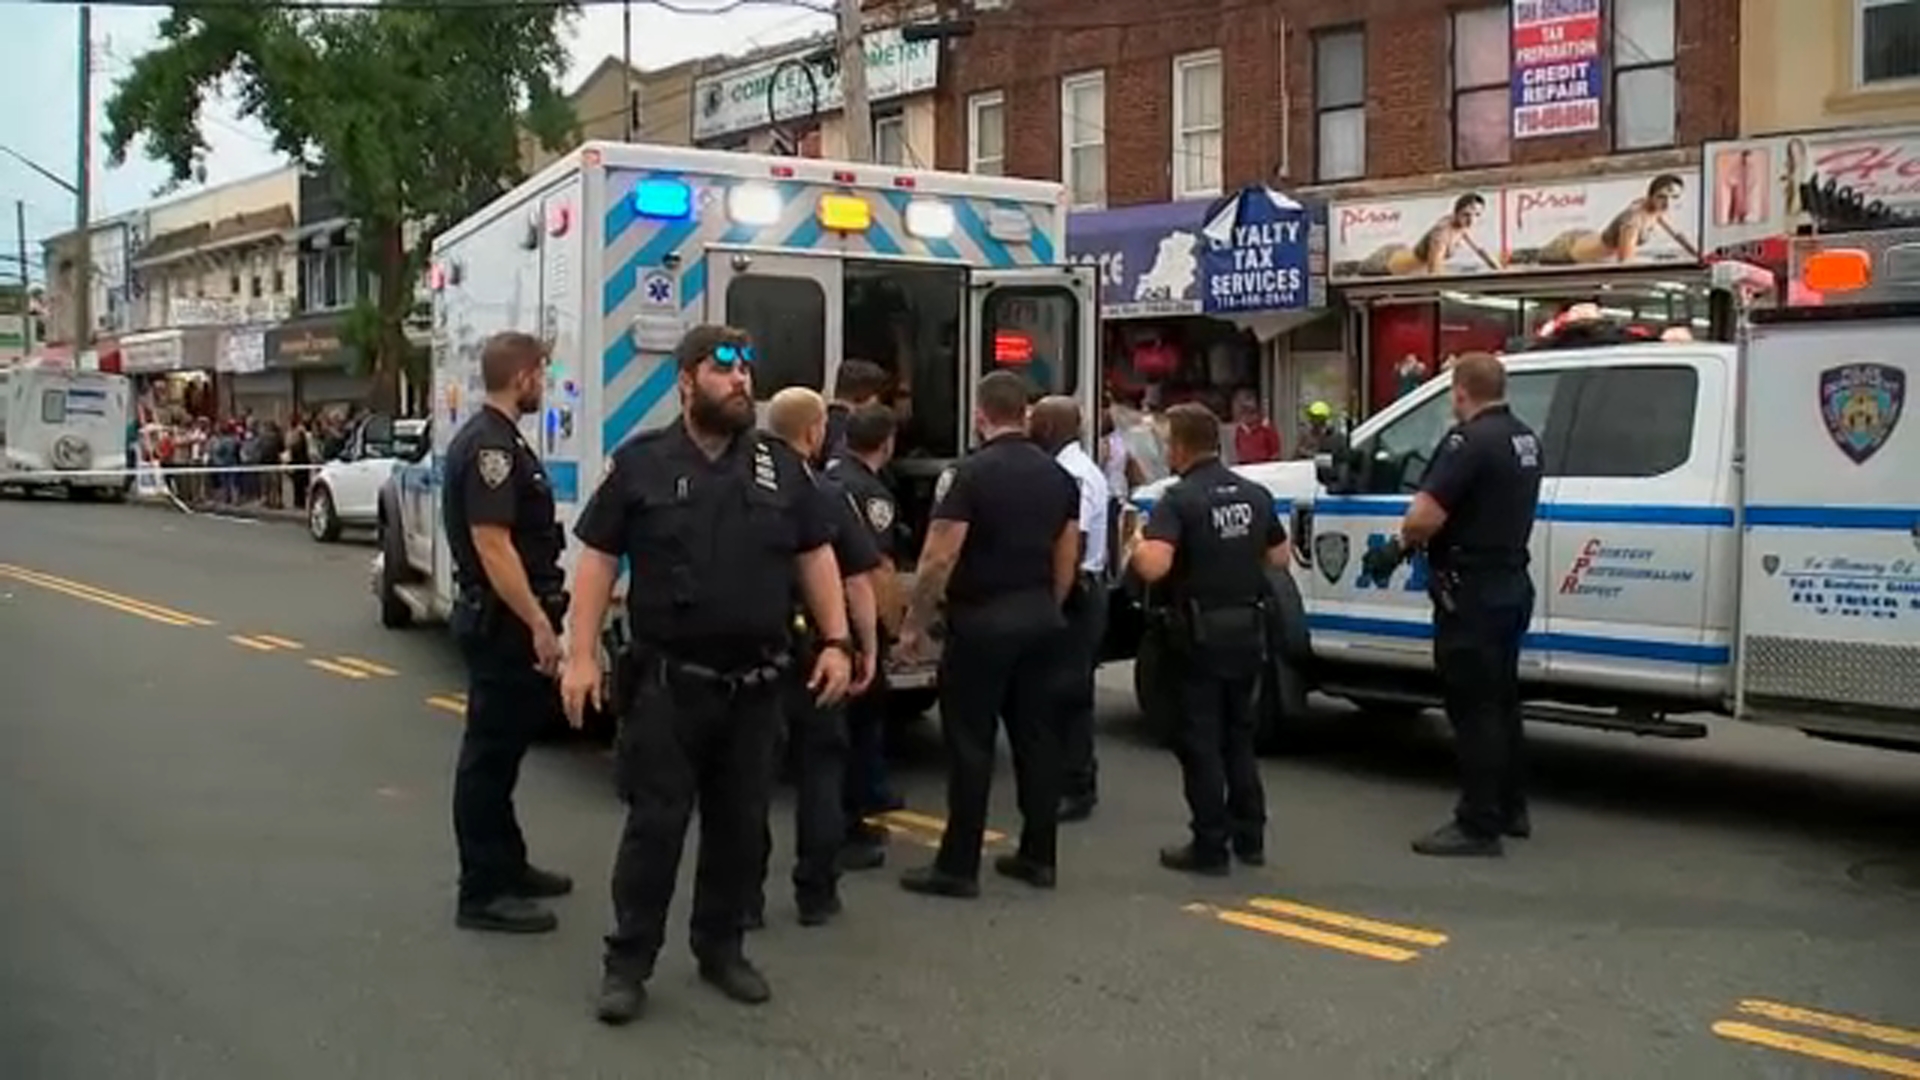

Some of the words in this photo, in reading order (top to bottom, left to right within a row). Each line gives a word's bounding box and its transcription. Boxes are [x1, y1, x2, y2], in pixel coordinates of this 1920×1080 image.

[1523, 62, 1589, 85] CREDIT
[1523, 80, 1588, 103] REPAIR
[1234, 248, 1273, 271] TAX
[1211, 269, 1300, 296] SERVICES
[1211, 503, 1252, 529] NYPD
